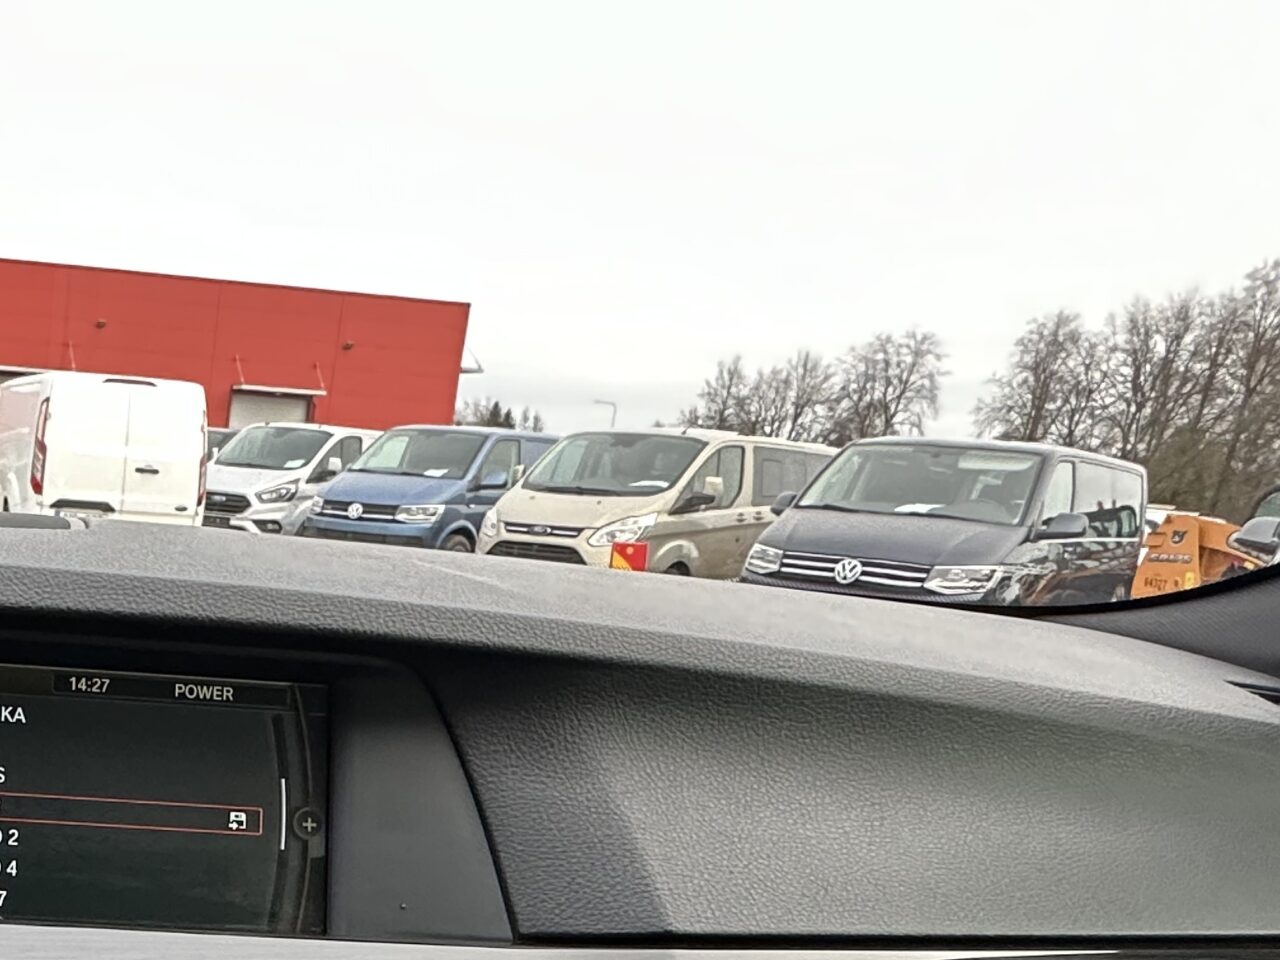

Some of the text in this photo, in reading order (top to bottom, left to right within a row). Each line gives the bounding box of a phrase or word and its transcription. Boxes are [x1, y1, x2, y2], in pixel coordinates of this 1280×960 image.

[70, 676, 110, 693] 14:27
[175, 683, 234, 701] POWER
[7, 828, 19, 846] 2
[6, 859, 18, 877] 4
